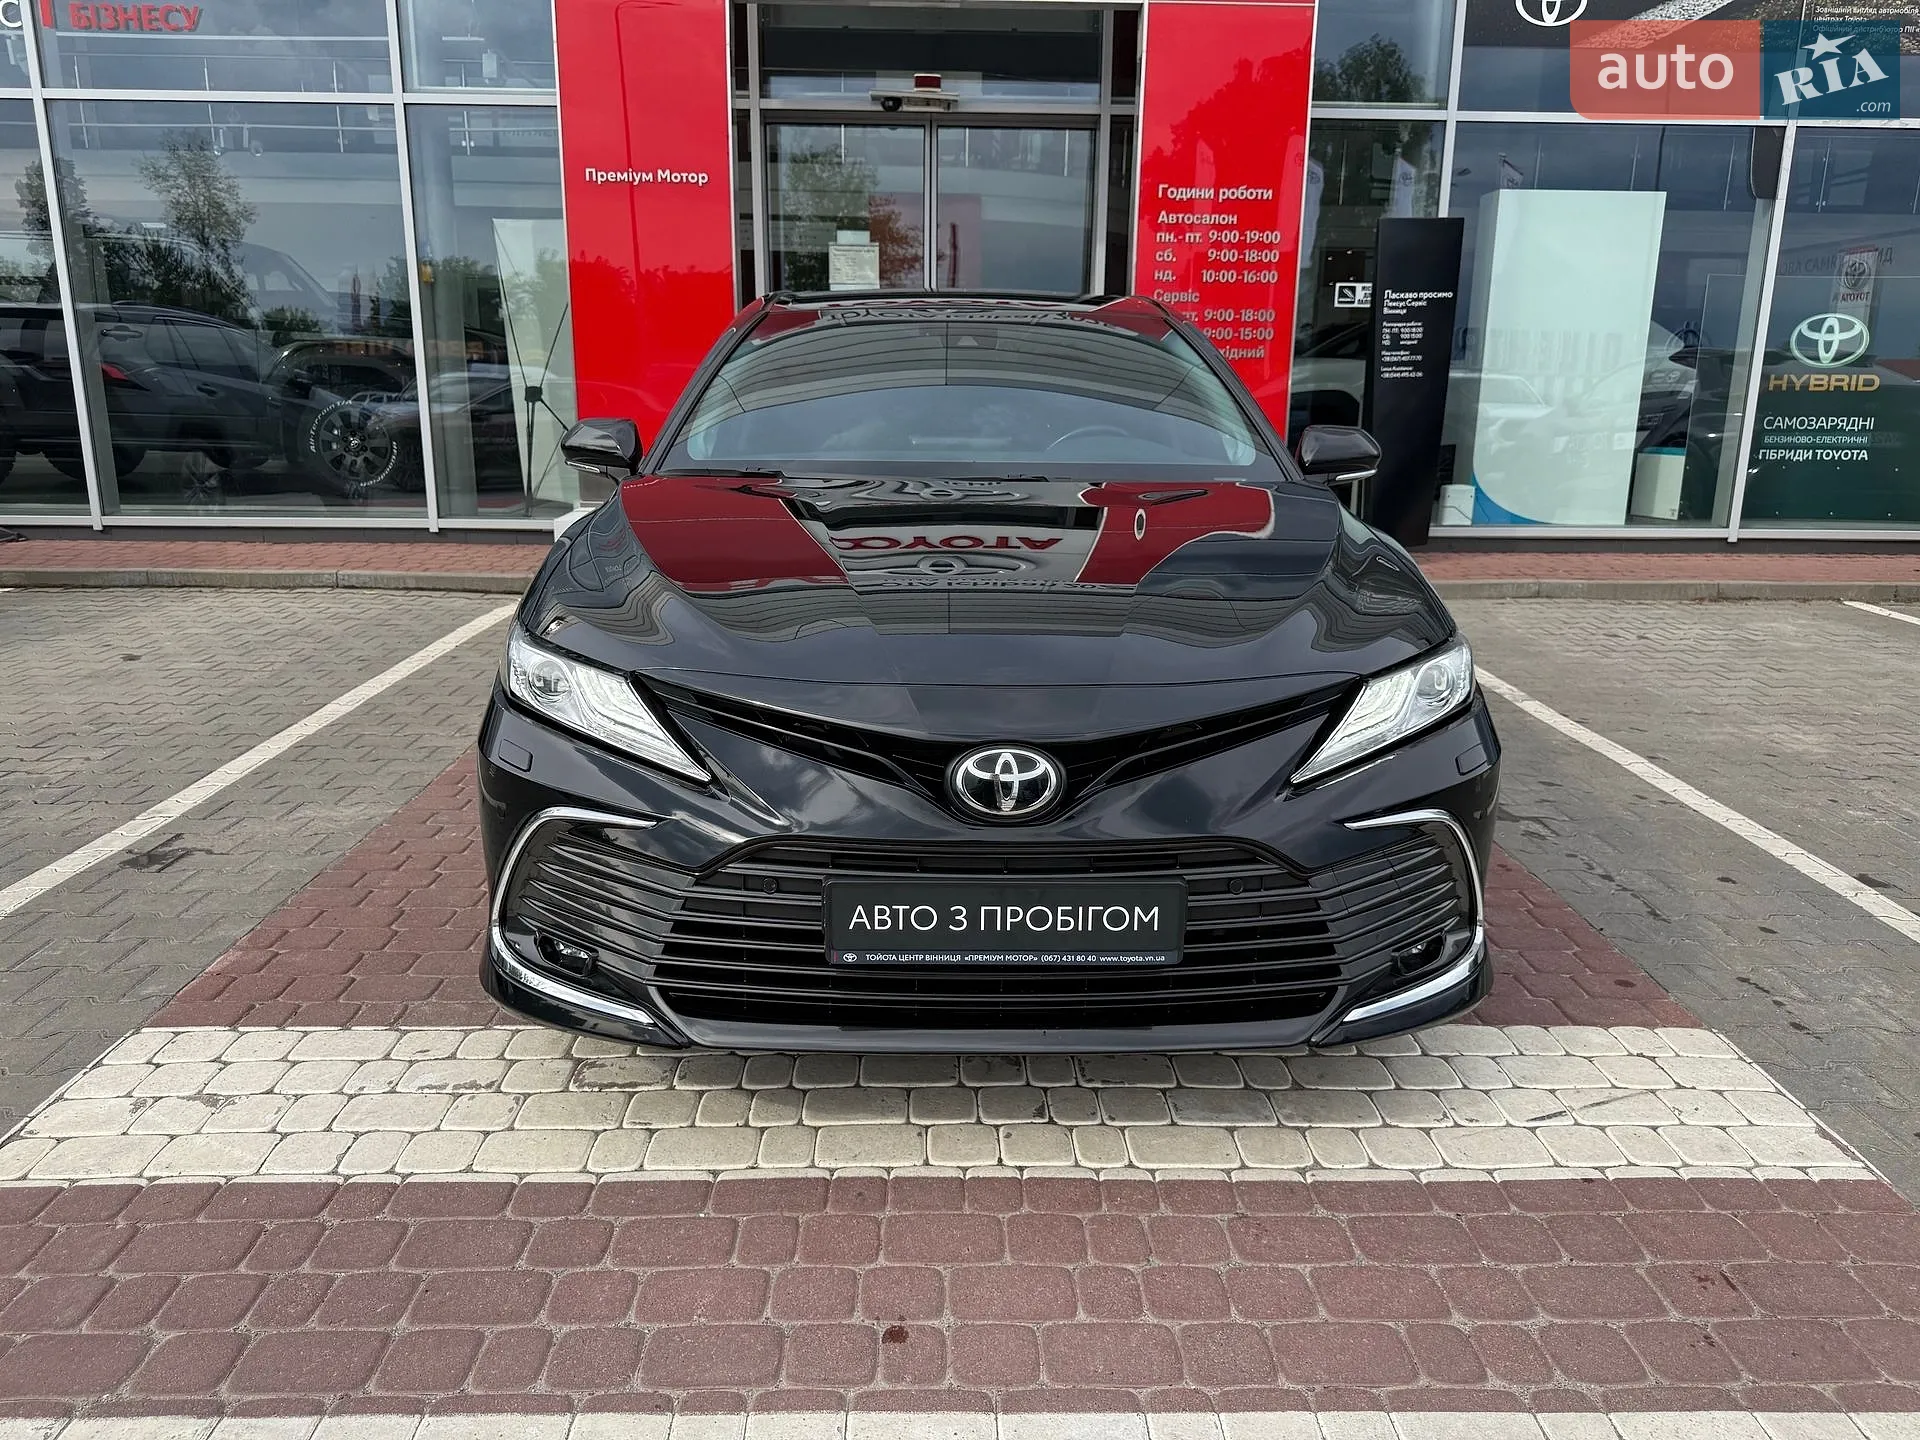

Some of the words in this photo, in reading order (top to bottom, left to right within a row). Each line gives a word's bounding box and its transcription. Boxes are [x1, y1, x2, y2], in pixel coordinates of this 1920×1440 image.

[68, 3, 200, 32] БІЗНЕСУ
[585, 168, 653, 185] Преміум
[657, 169, 708, 186] Мотор
[1158, 184, 1214, 201] Години
[1219, 185, 1273, 202] роботи
[1157, 211, 1237, 225] Автосалон
[1208, 230, 1281, 244] 9:00-19:00
[1156, 250, 1176, 262] сб.
[1207, 249, 1279, 262] 9:00-18:00
[1154, 270, 1176, 281] нд.
[1202, 270, 1278, 283] 10:00-16:00
[1154, 288, 1200, 304] Сервіс
[1384, 289, 1418, 300] Ласкаво
[1419, 291, 1453, 301] просимо
[1204, 308, 1275, 322] 9:00-18:00
[1203, 327, 1274, 340] 9:00-15:00
[1768, 374, 1880, 391] HYBRID
[1763, 416, 1875, 432] САМОЗАРЯДНІ
[1764, 436, 1868, 444] БЕНЗИНОВО-ЕЛЕКТРИЧНІ
[1758, 450, 1814, 461] ГІБРИДИ
[1816, 450, 1869, 460] TOYOTA
[849, 905, 938, 931] АВТО
[949, 905, 968, 931] З
[981, 905, 1159, 932] ПРОБІГОМ
[866, 953, 898, 962] ТОЙОТА
[899, 954, 924, 963] ЦЕНТР
[926, 954, 961, 962] ВІННИЦЯ
[964, 954, 1004, 962] «ПРЕМІУМ
[1005, 954, 1038, 962] МОТОР»
[1041, 954, 1061, 963] (067)
[1099, 955, 1165, 964] www.toyota.vn.ua
